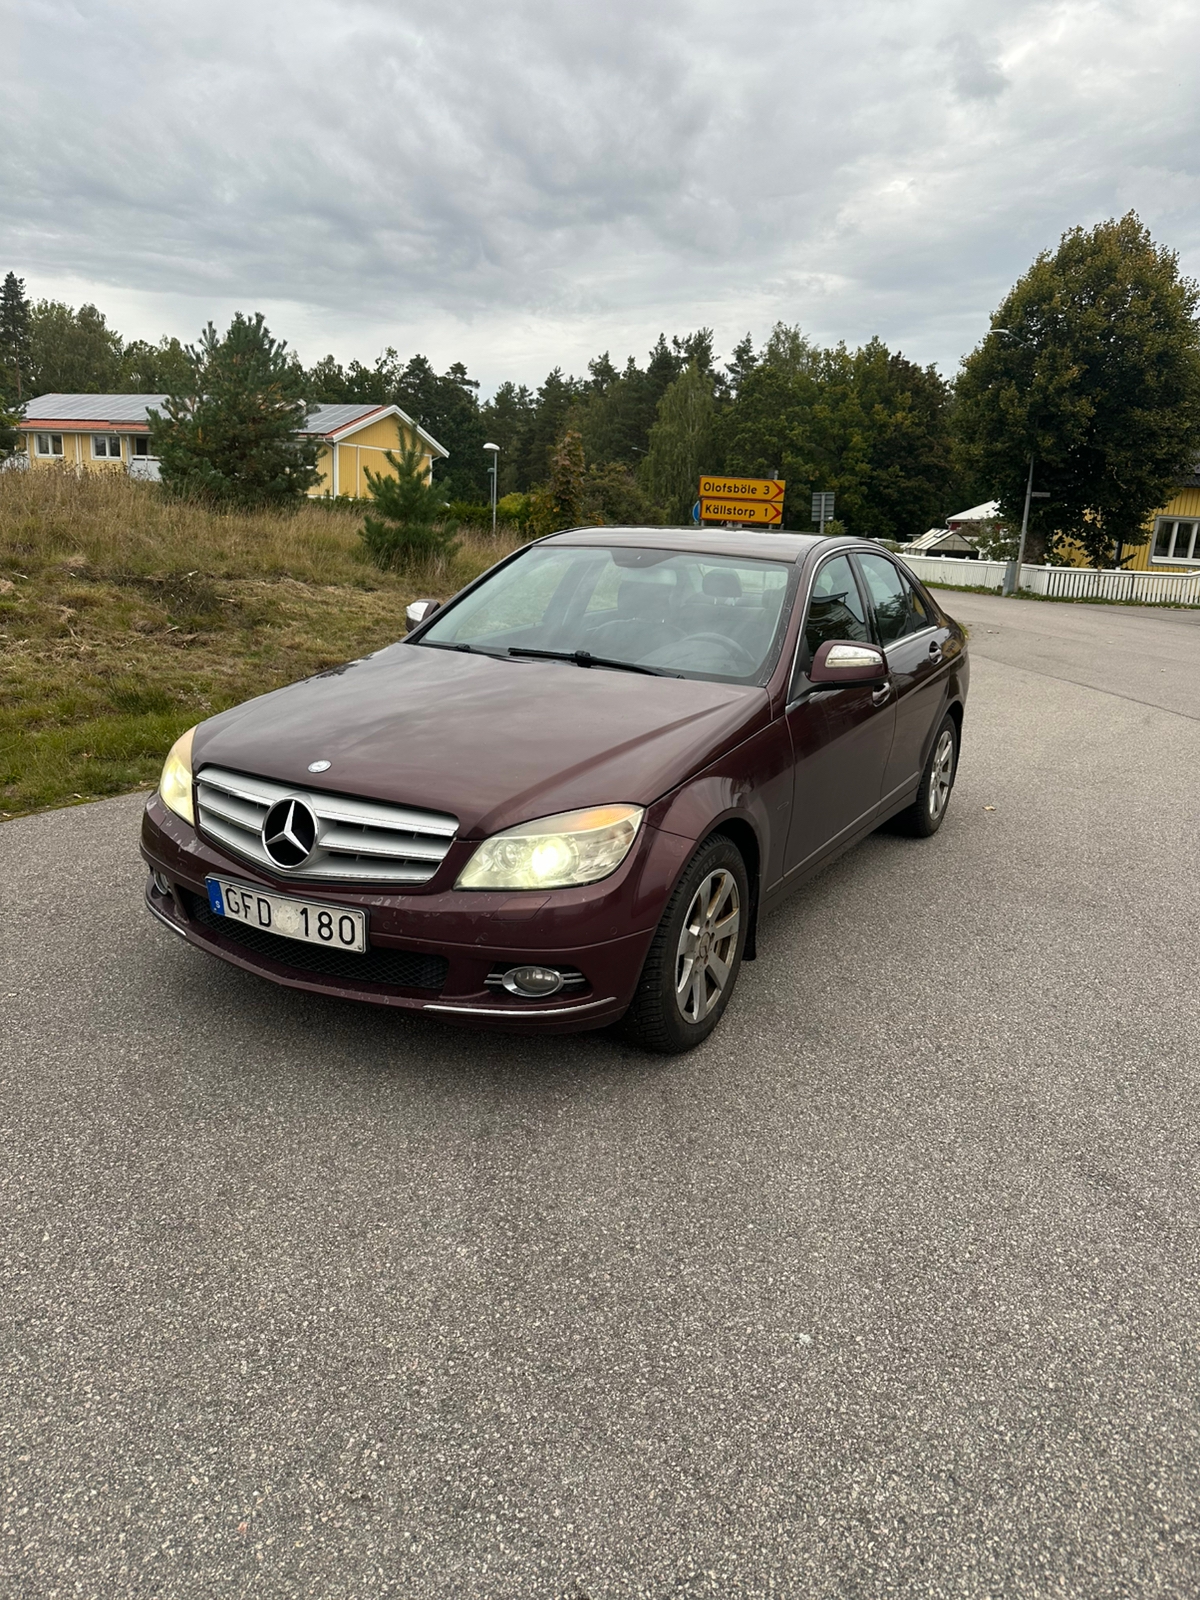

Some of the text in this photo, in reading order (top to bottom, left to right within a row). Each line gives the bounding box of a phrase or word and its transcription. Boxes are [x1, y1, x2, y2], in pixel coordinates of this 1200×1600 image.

[703, 481, 770, 495] Olofsböle 3
[705, 505, 768, 518] Källstorp 1
[215, 900, 221, 909] S
[225, 888, 356, 946] GFD 180
